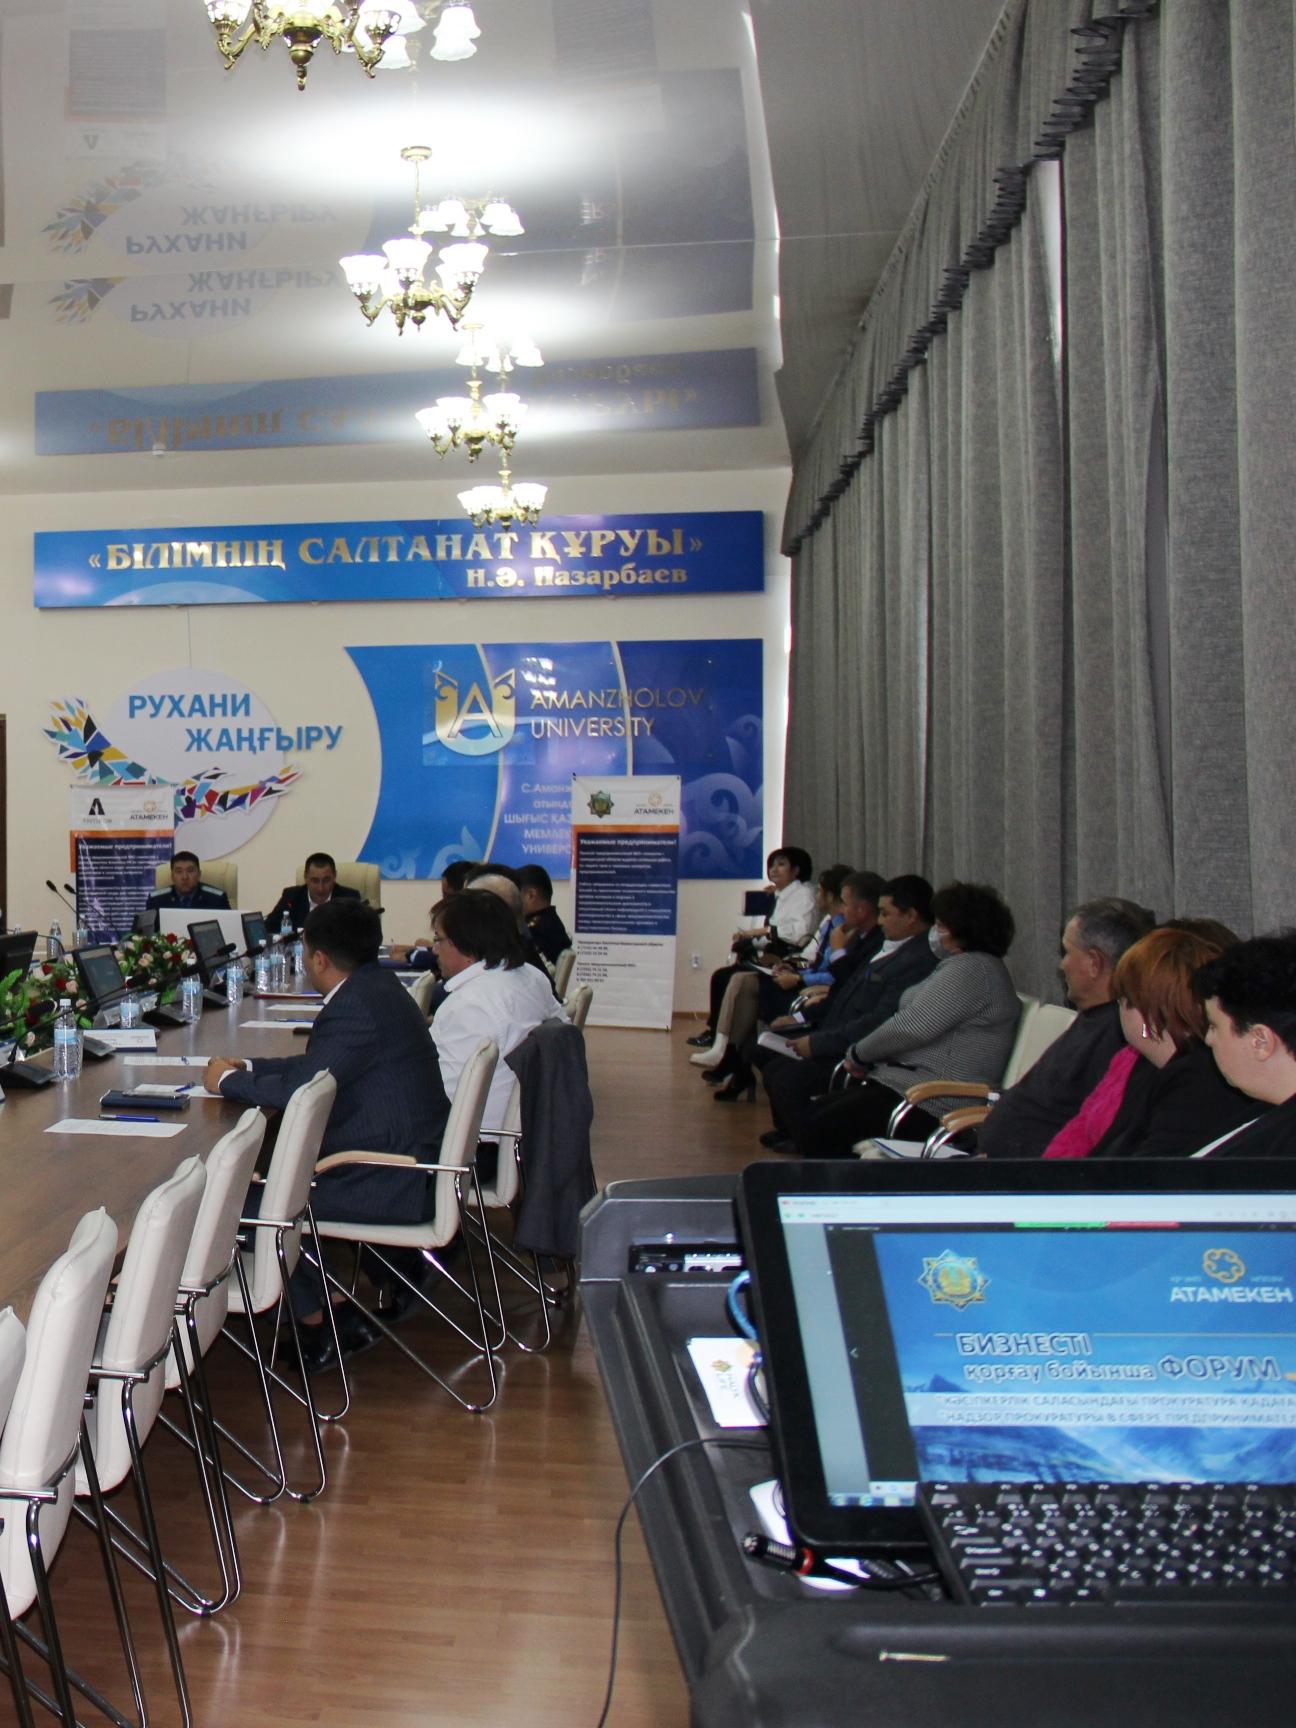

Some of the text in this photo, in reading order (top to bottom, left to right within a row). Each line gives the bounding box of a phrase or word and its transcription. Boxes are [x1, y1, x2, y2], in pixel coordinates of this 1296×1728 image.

[89, 528, 703, 571] «БІЛІМНІҢ САЛТАНАТ ҚҰРУЫ»
[128, 693, 251, 719] РУХАНИ
[530, 688, 704, 709] AMANZHOLOV
[185, 725, 343, 754] ЖАҢҒЫРУ
[530, 717, 653, 739] UNIVERSITY
[1169, 1286, 1294, 1303] АТАМЕКЕН
[957, 1333, 1093, 1356] БИЗНЕСТІ
[1047, 1360, 1156, 1380] бойынша
[1160, 1354, 1281, 1382] ФОРУМ
